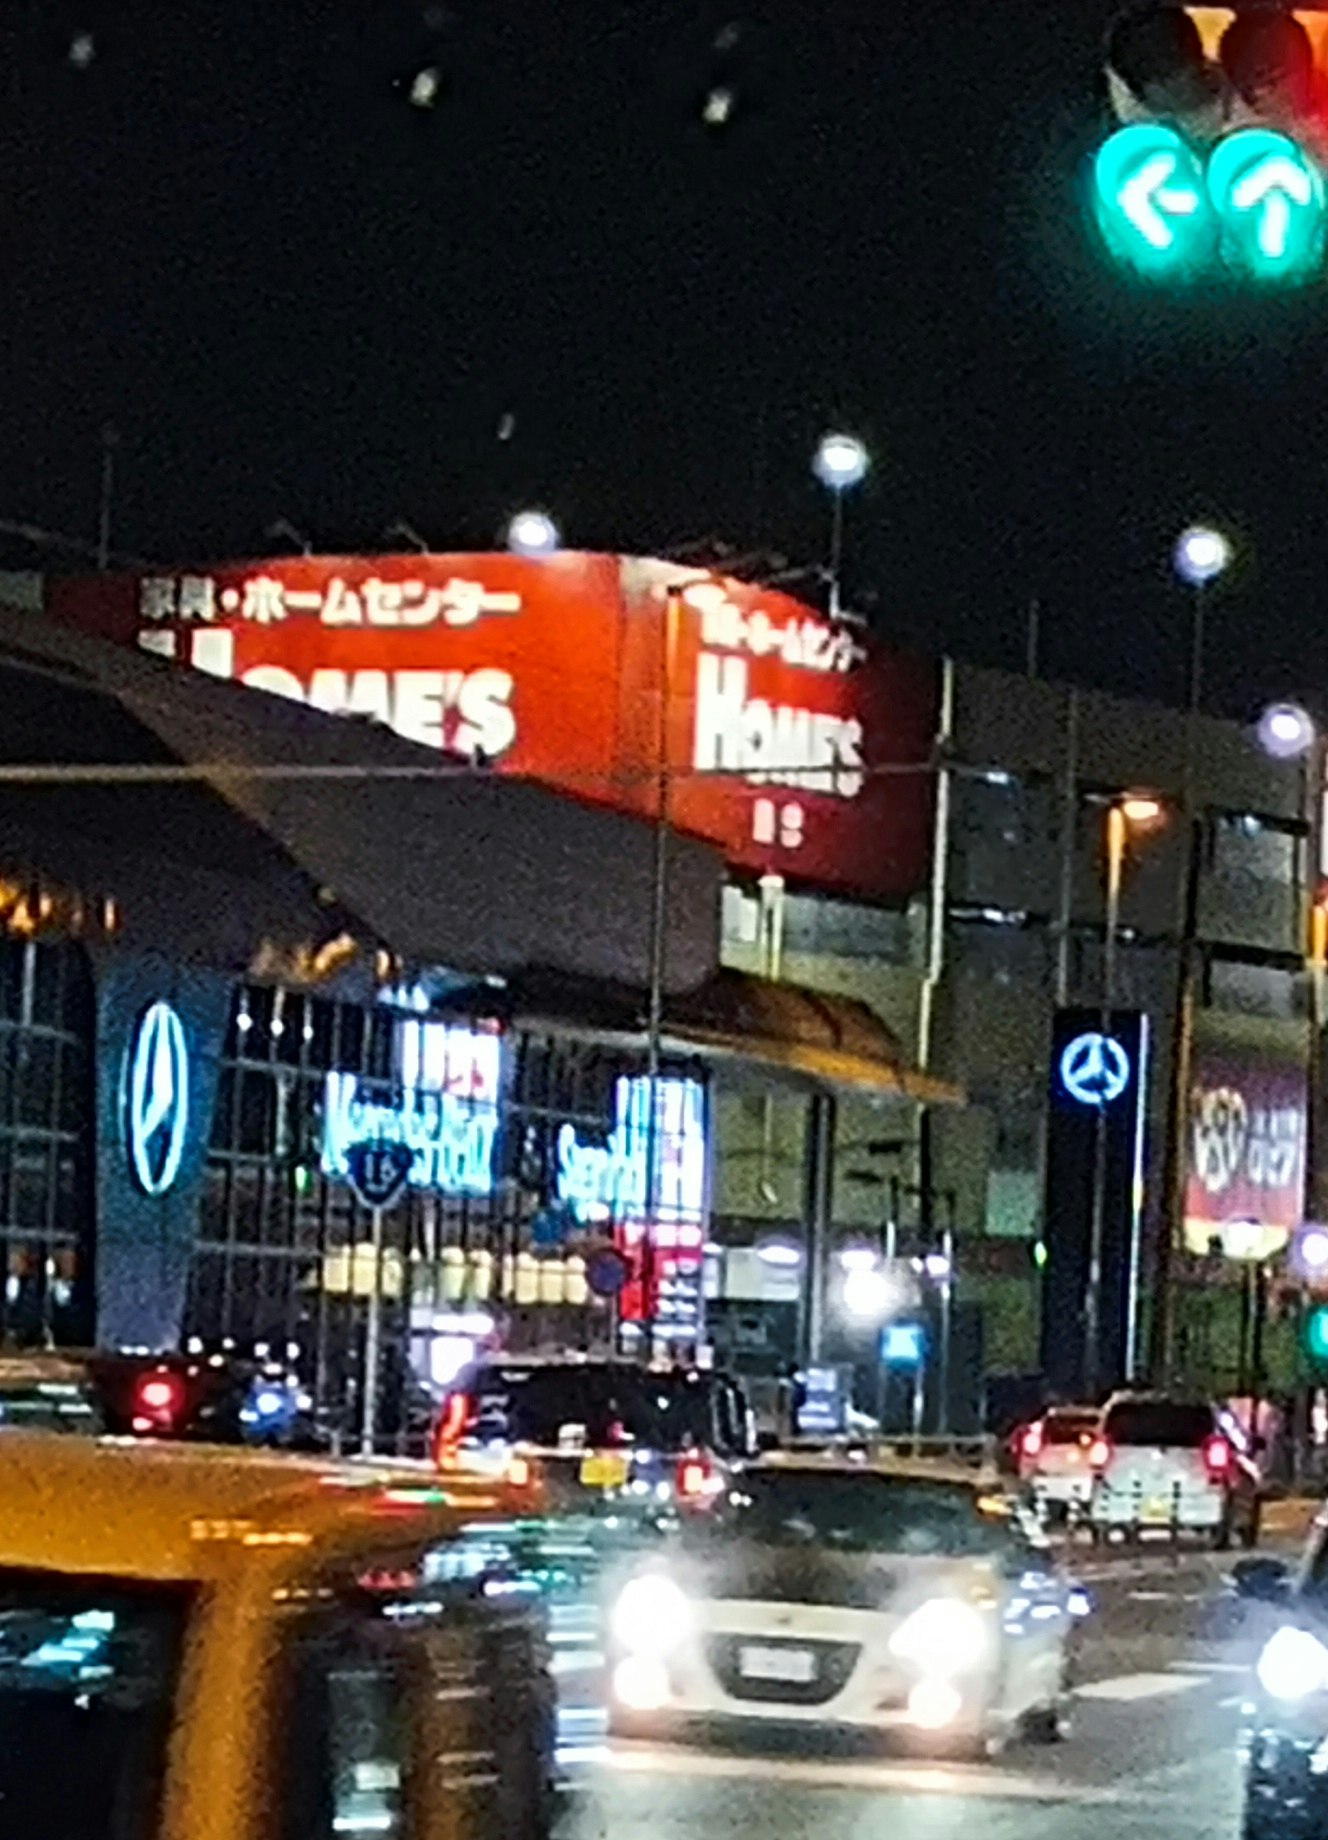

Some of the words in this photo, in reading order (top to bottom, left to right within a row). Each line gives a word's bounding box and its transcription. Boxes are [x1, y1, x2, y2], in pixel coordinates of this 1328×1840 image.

[140, 574, 523, 626] 家具・ホームセンター
